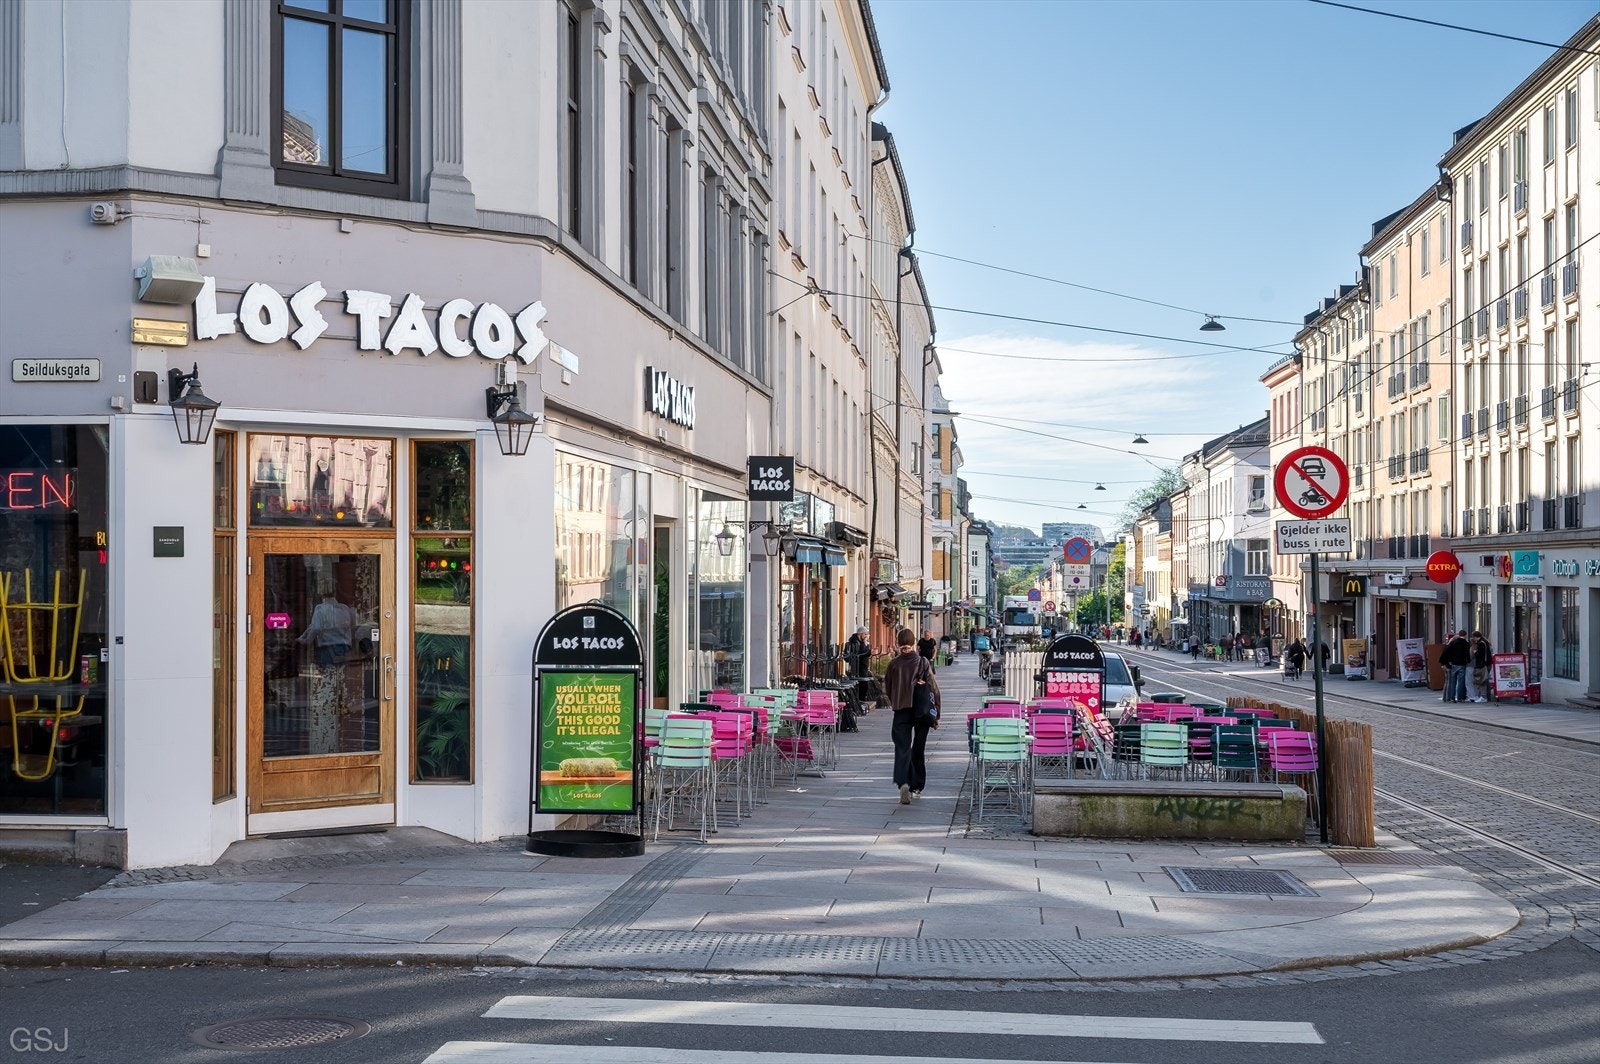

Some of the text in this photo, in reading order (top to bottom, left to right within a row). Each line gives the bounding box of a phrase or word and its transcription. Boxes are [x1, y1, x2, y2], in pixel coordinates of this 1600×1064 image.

[194, 275, 549, 365] LOS TACOS
[22, 363, 90, 377] Seilduksgata
[648, 366, 696, 430] LOS TACOS
[759, 467, 783, 478] LOS
[751, 480, 791, 491] TACOS
[1280, 524, 1348, 537] Gjelder ikke
[1283, 537, 1345, 549] buss i rute
[1428, 563, 1457, 571] EXTRA
[553, 636, 625, 650] LOS TACOS
[1053, 652, 1095, 660] LOS TACOS
[1047, 672, 1100, 683] LUNCH
[1047, 683, 1100, 694] DEALS
[556, 694, 621, 704] YOU ROLL
[556, 705, 621, 713] SOMETHING
[557, 715, 621, 725] THIS GOOD
[557, 726, 621, 736] IT'S ILLEGAL
